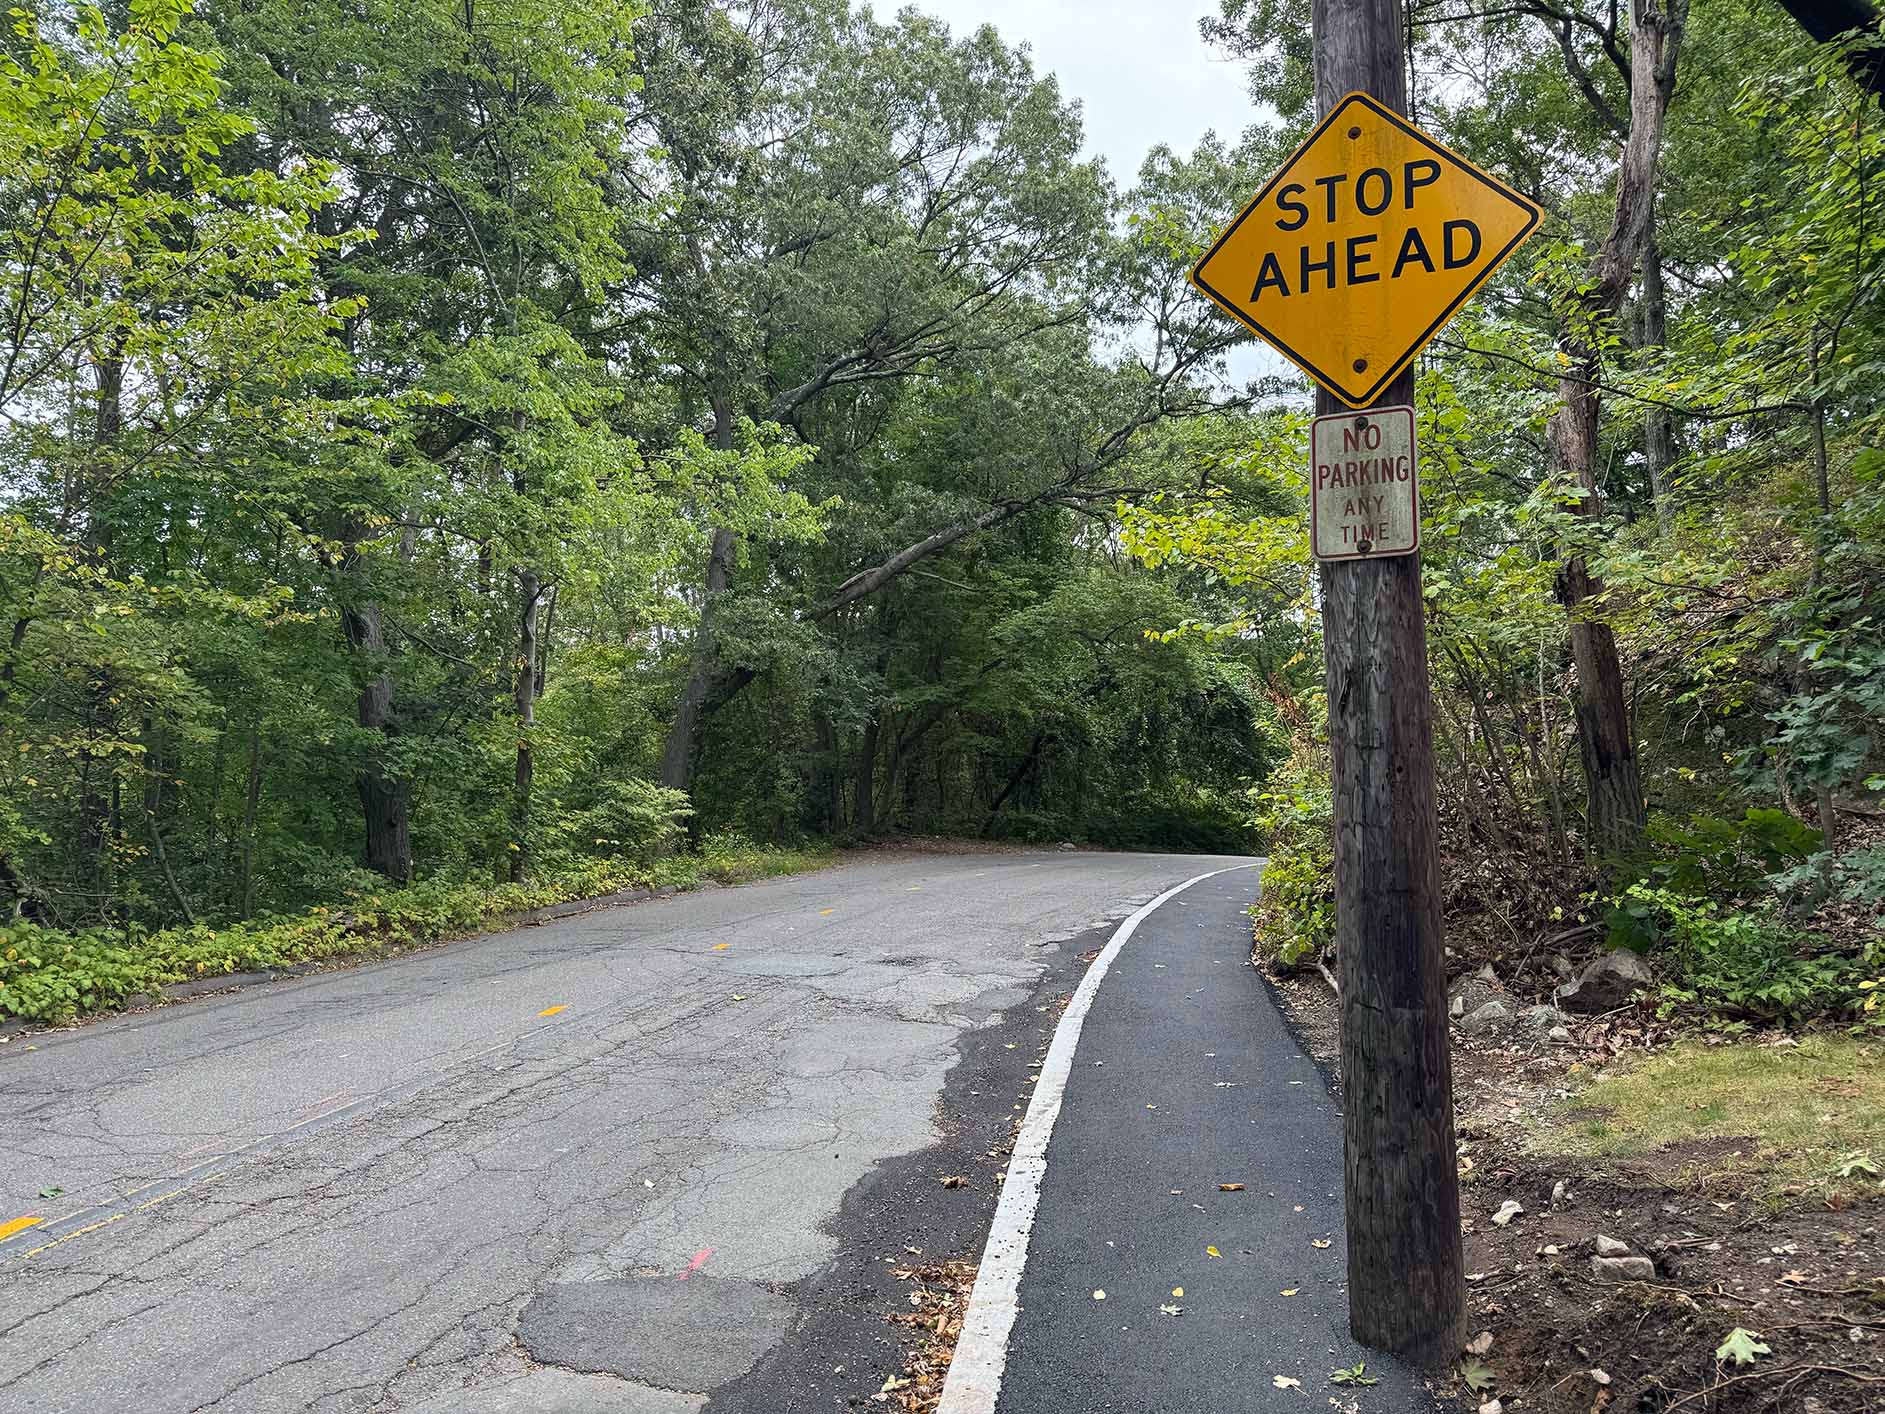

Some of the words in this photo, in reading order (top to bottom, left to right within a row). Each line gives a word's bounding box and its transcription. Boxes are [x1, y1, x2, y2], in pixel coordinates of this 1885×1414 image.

[1275, 158, 1442, 232] STOP
[1249, 219, 1482, 303] AHEAD
[1343, 424, 1381, 454] NO
[1318, 455, 1409, 490] PARKING
[1344, 495, 1384, 517] ANY
[1341, 522, 1389, 544] TIME
